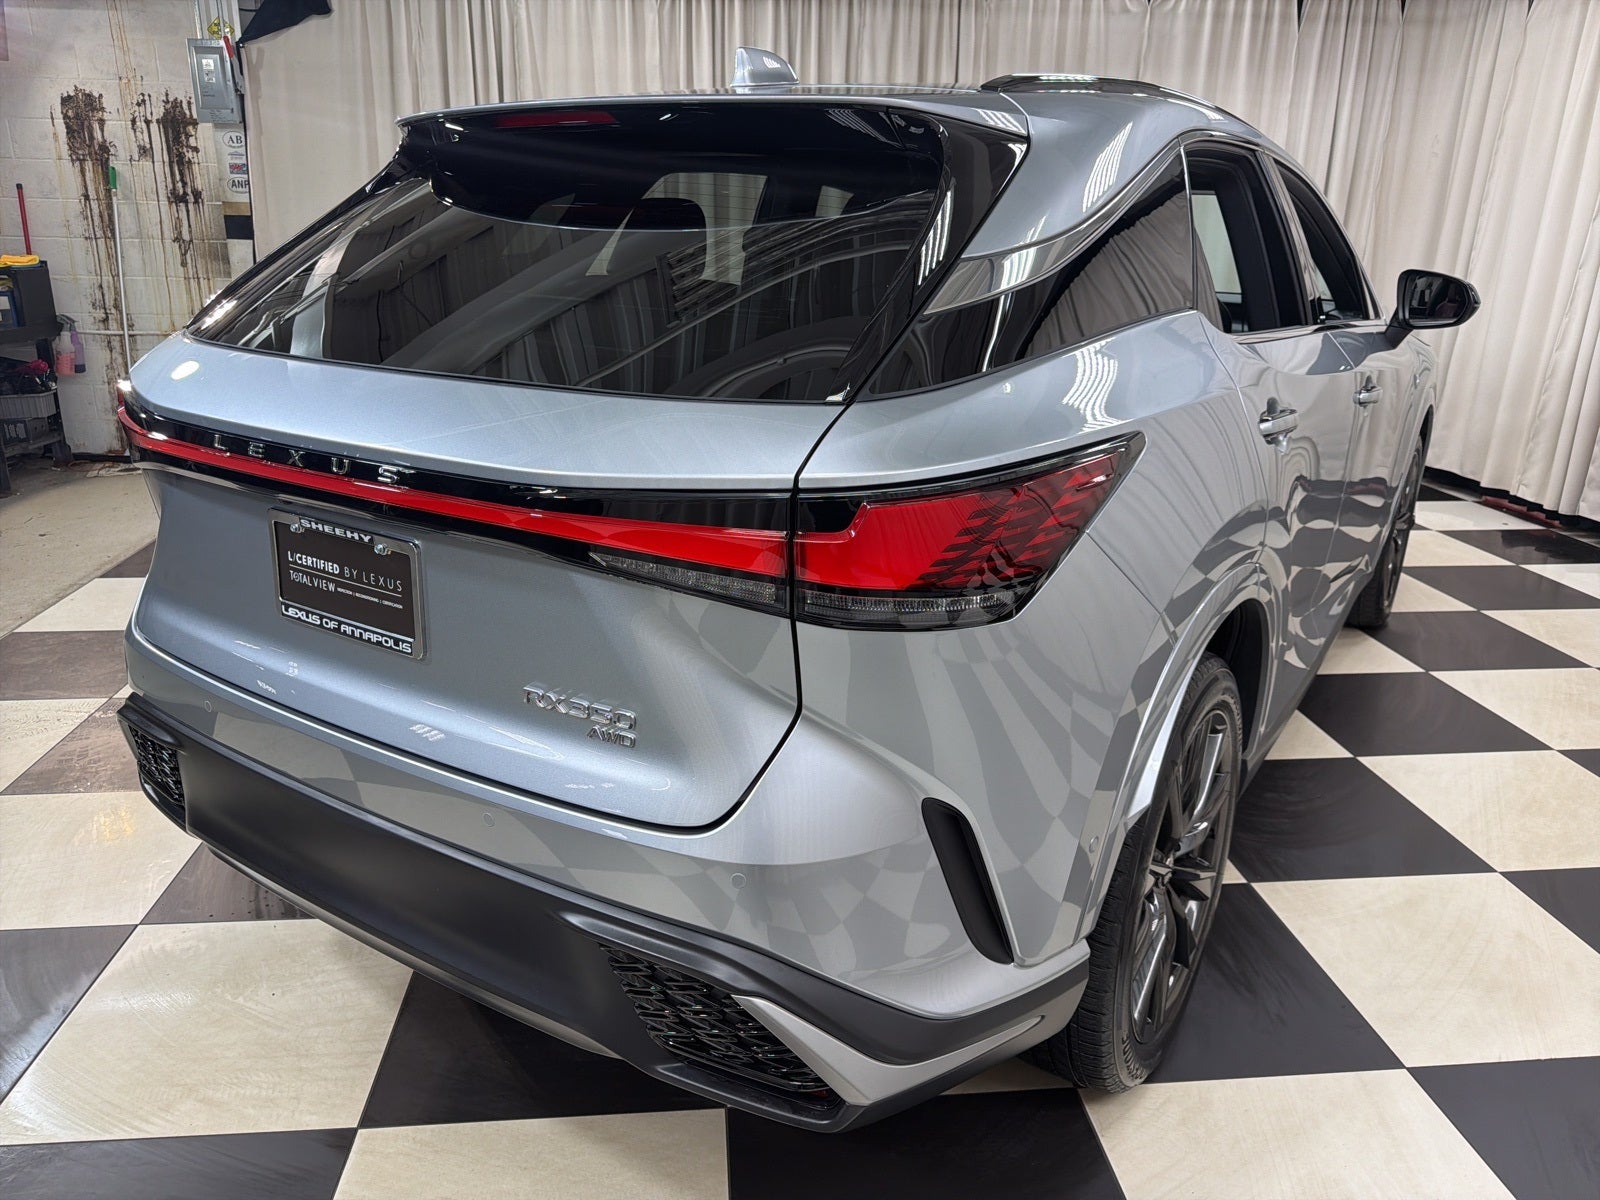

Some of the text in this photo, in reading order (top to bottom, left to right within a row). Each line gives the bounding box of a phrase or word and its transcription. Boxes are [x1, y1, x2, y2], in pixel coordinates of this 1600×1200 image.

[227, 135, 243, 145] AB
[213, 434, 400, 484] LEXUS
[300, 519, 371, 542] SHEEHY
[344, 566, 358, 579] BY
[362, 571, 403, 592] LEXUS
[281, 605, 412, 653] LEXUS OF ANNAPOLIS
[587, 725, 637, 749] AWD
